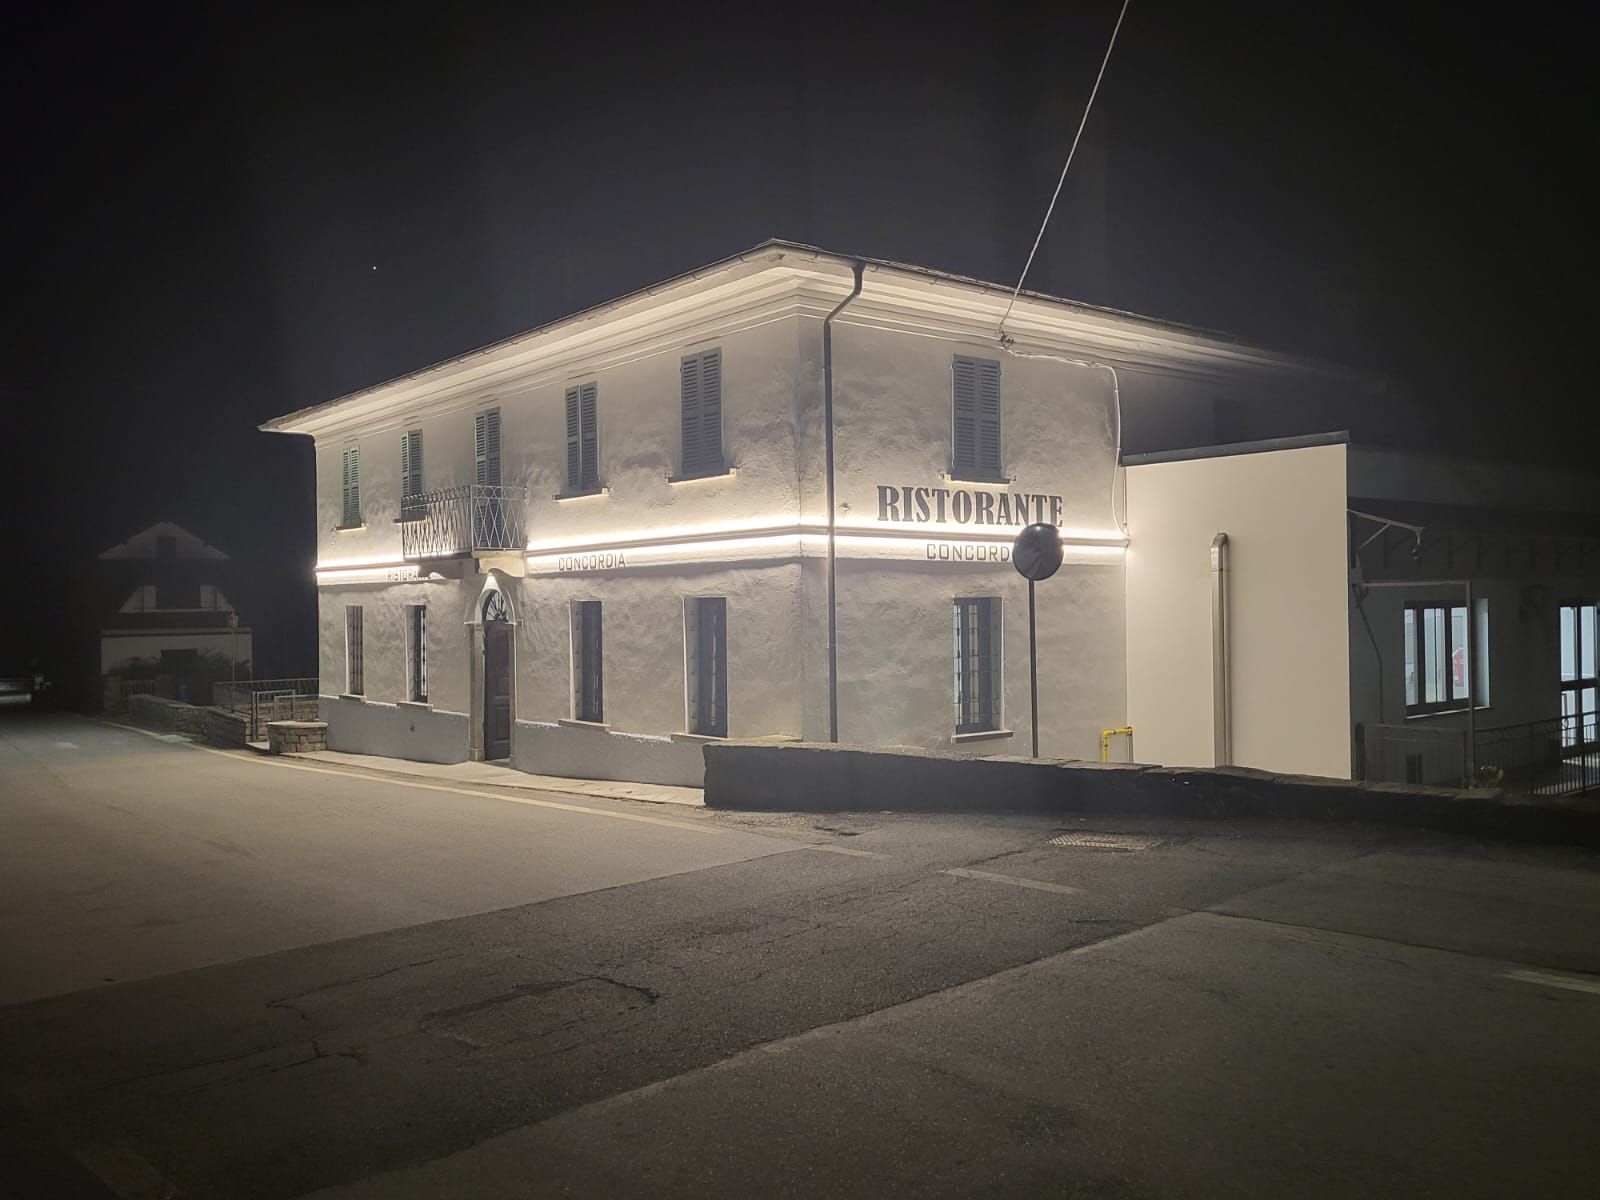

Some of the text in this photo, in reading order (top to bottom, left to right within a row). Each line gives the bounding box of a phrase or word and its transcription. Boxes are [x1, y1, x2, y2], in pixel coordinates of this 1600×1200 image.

[877, 485, 1062, 528] RISTORANTE
[387, 551, 626, 583] RISTORA CONCORDIA
[926, 543, 1010, 562] CONCORD
